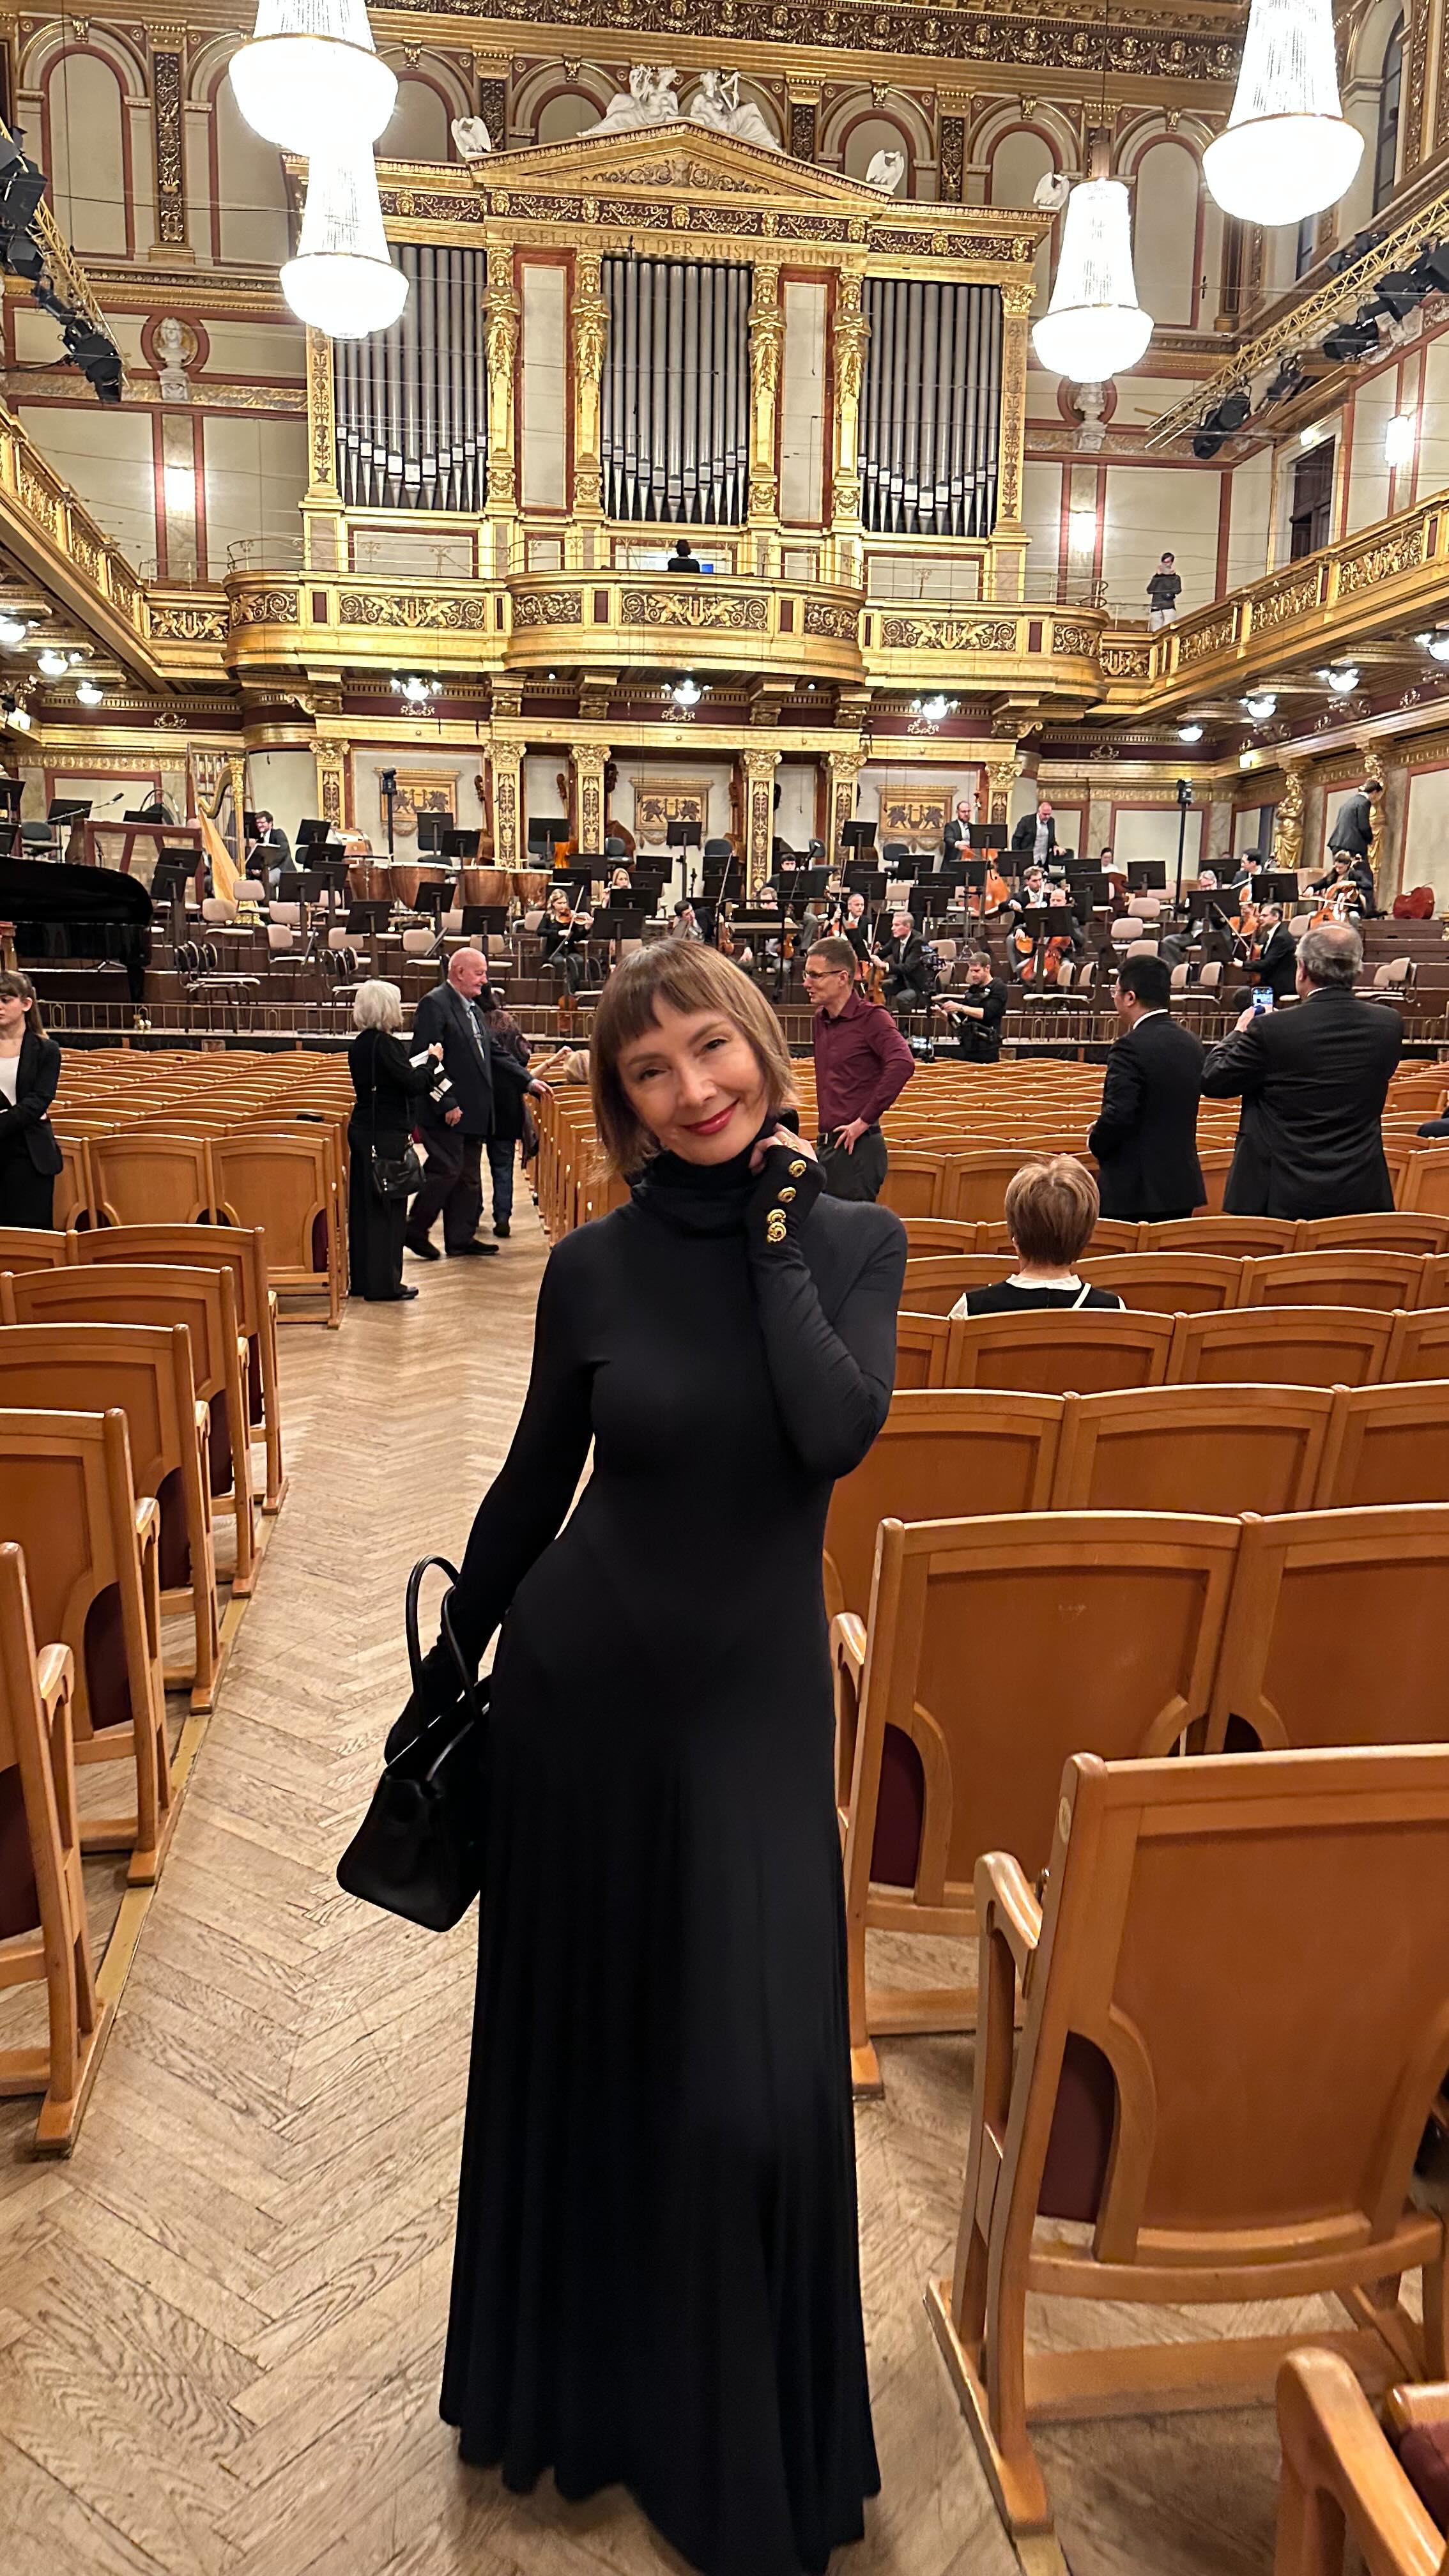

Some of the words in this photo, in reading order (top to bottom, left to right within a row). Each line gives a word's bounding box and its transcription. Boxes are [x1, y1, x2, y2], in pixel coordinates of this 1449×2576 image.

[502, 227, 650, 252] GESELLSCHAT
[656, 240, 694, 255] DER
[702, 242, 854, 266] MUSIKFREUNDE
